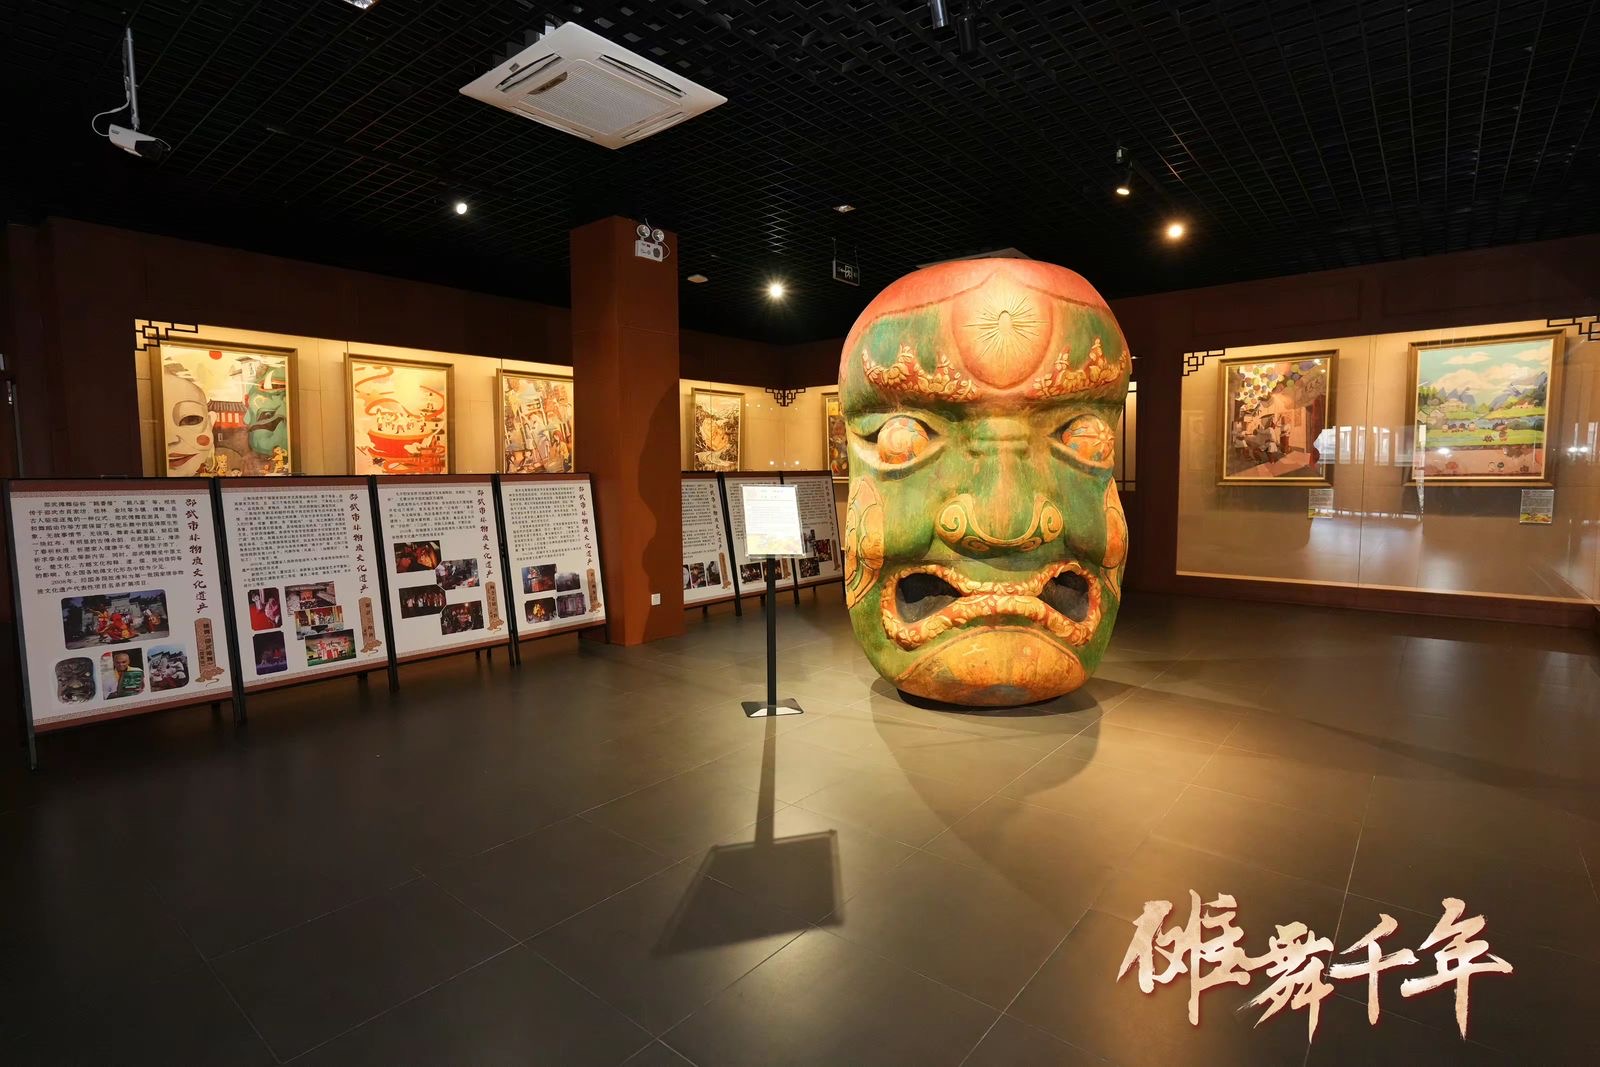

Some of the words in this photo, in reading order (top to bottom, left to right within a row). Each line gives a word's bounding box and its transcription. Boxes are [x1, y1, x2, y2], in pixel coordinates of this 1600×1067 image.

[185, 498, 208, 613] 邵武市非物质文化遗产
